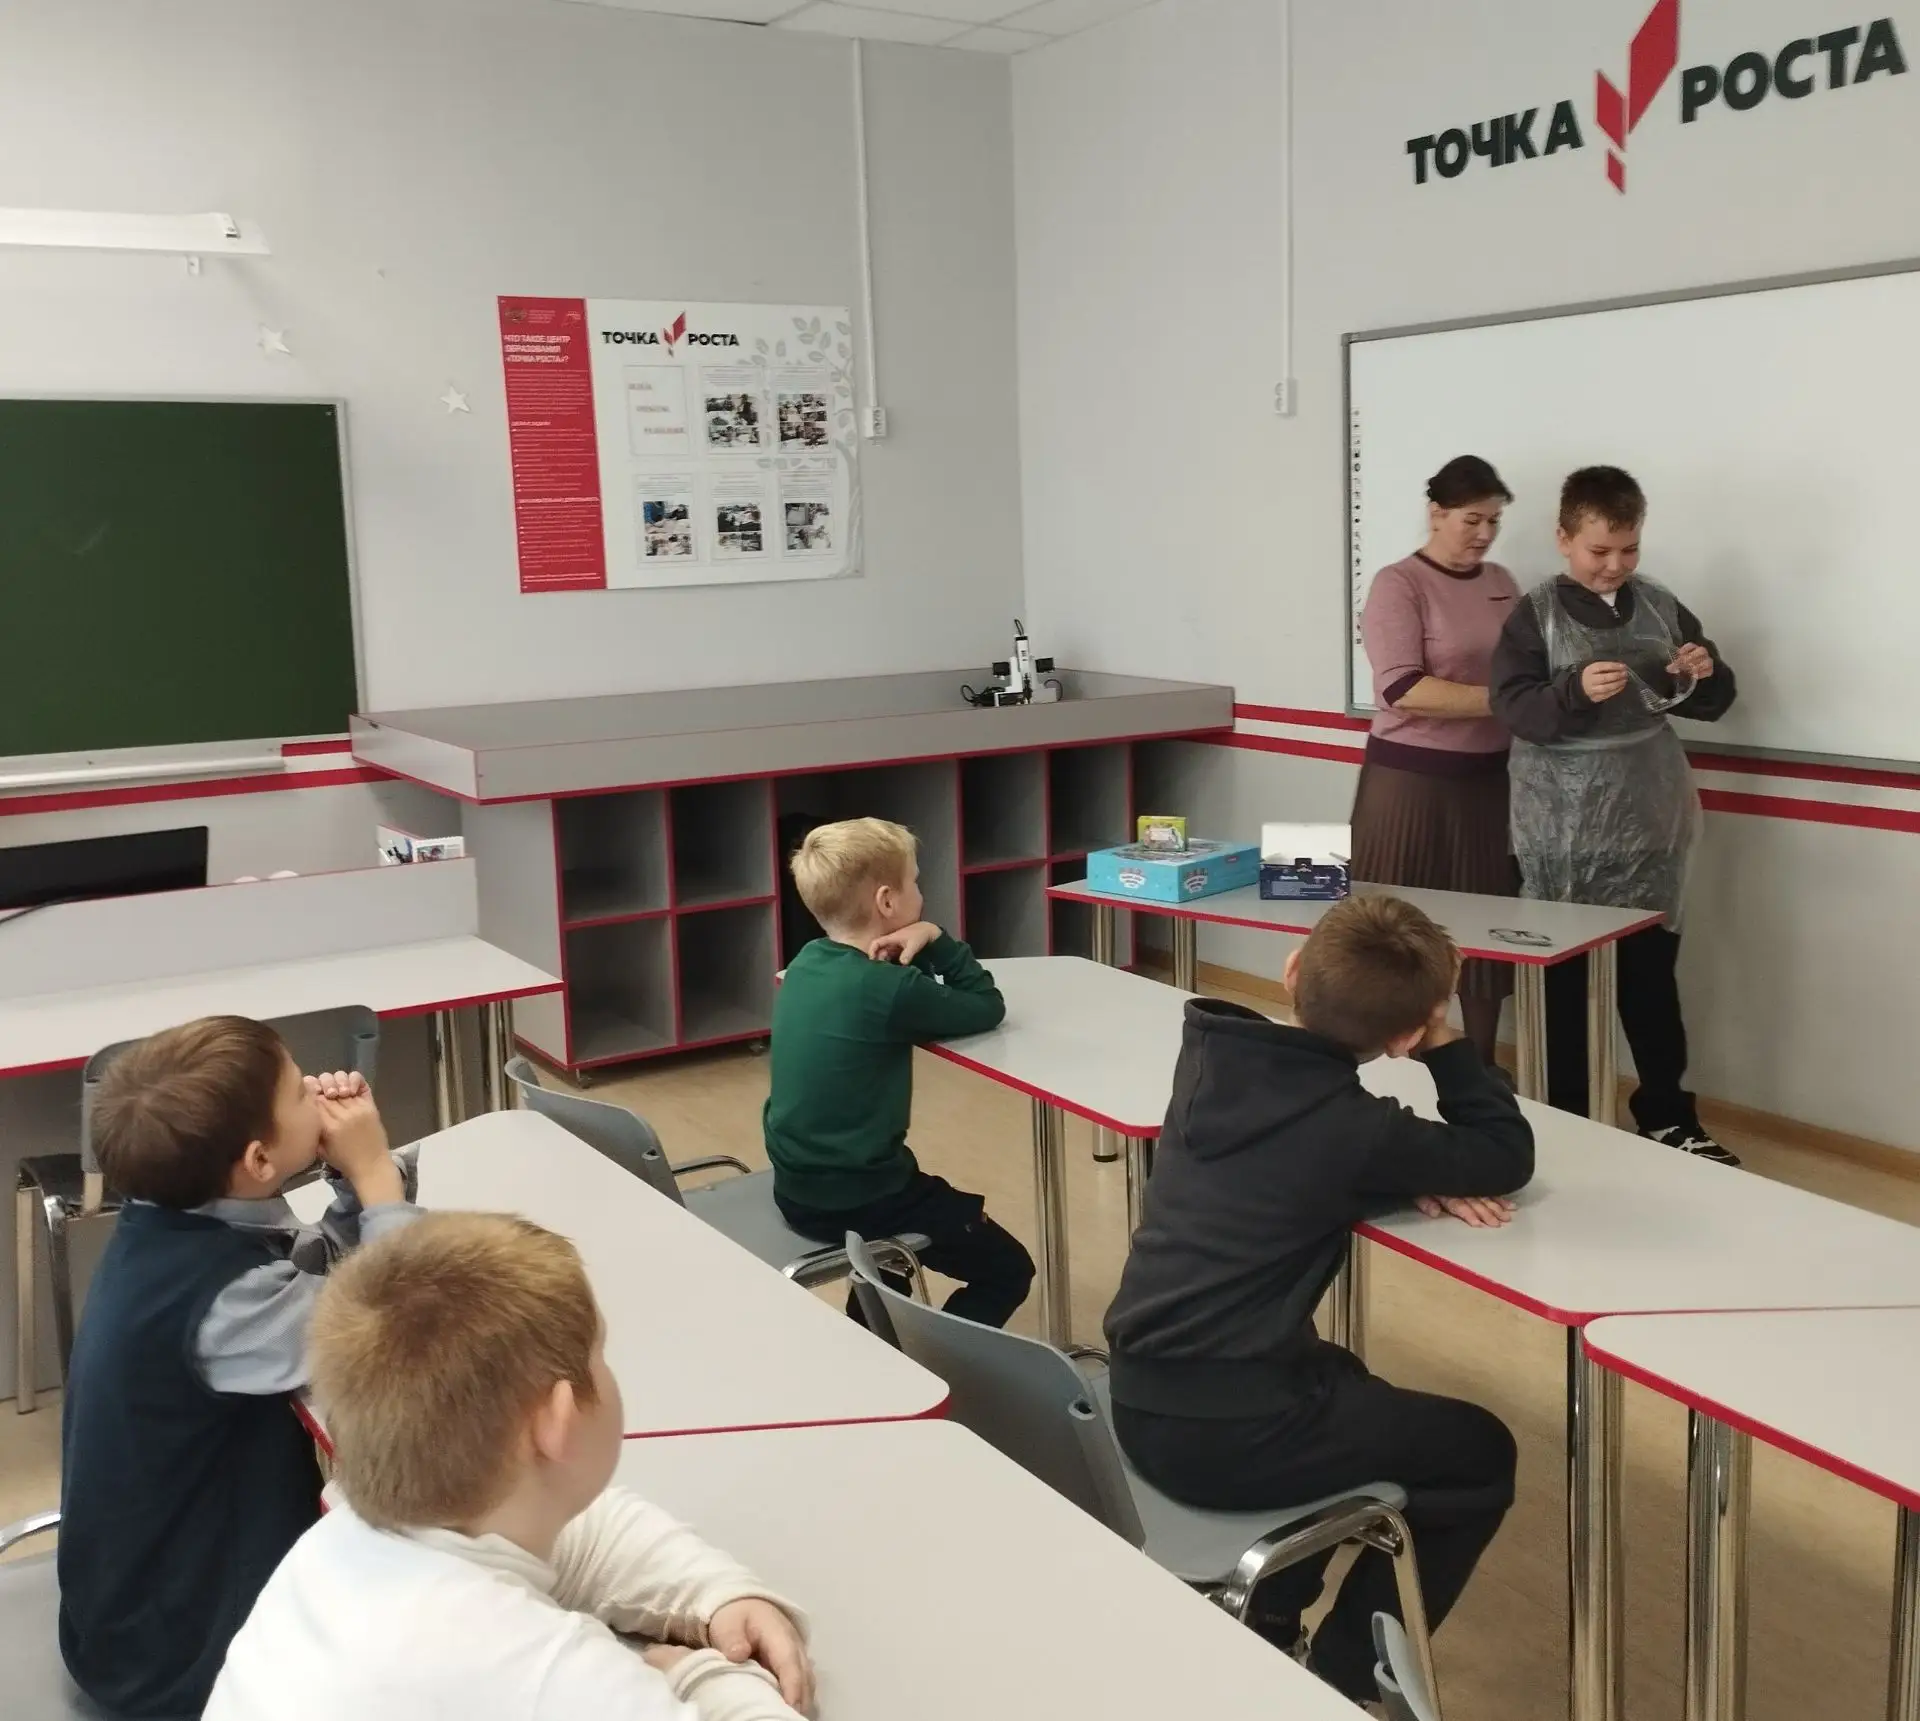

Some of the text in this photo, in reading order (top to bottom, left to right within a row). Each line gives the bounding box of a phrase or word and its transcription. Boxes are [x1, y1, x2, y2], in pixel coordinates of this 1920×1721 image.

[1406, 17, 1909, 185] ТОЧКА РОСТА
[602, 331, 739, 346] ТОЧКА РОСТА
